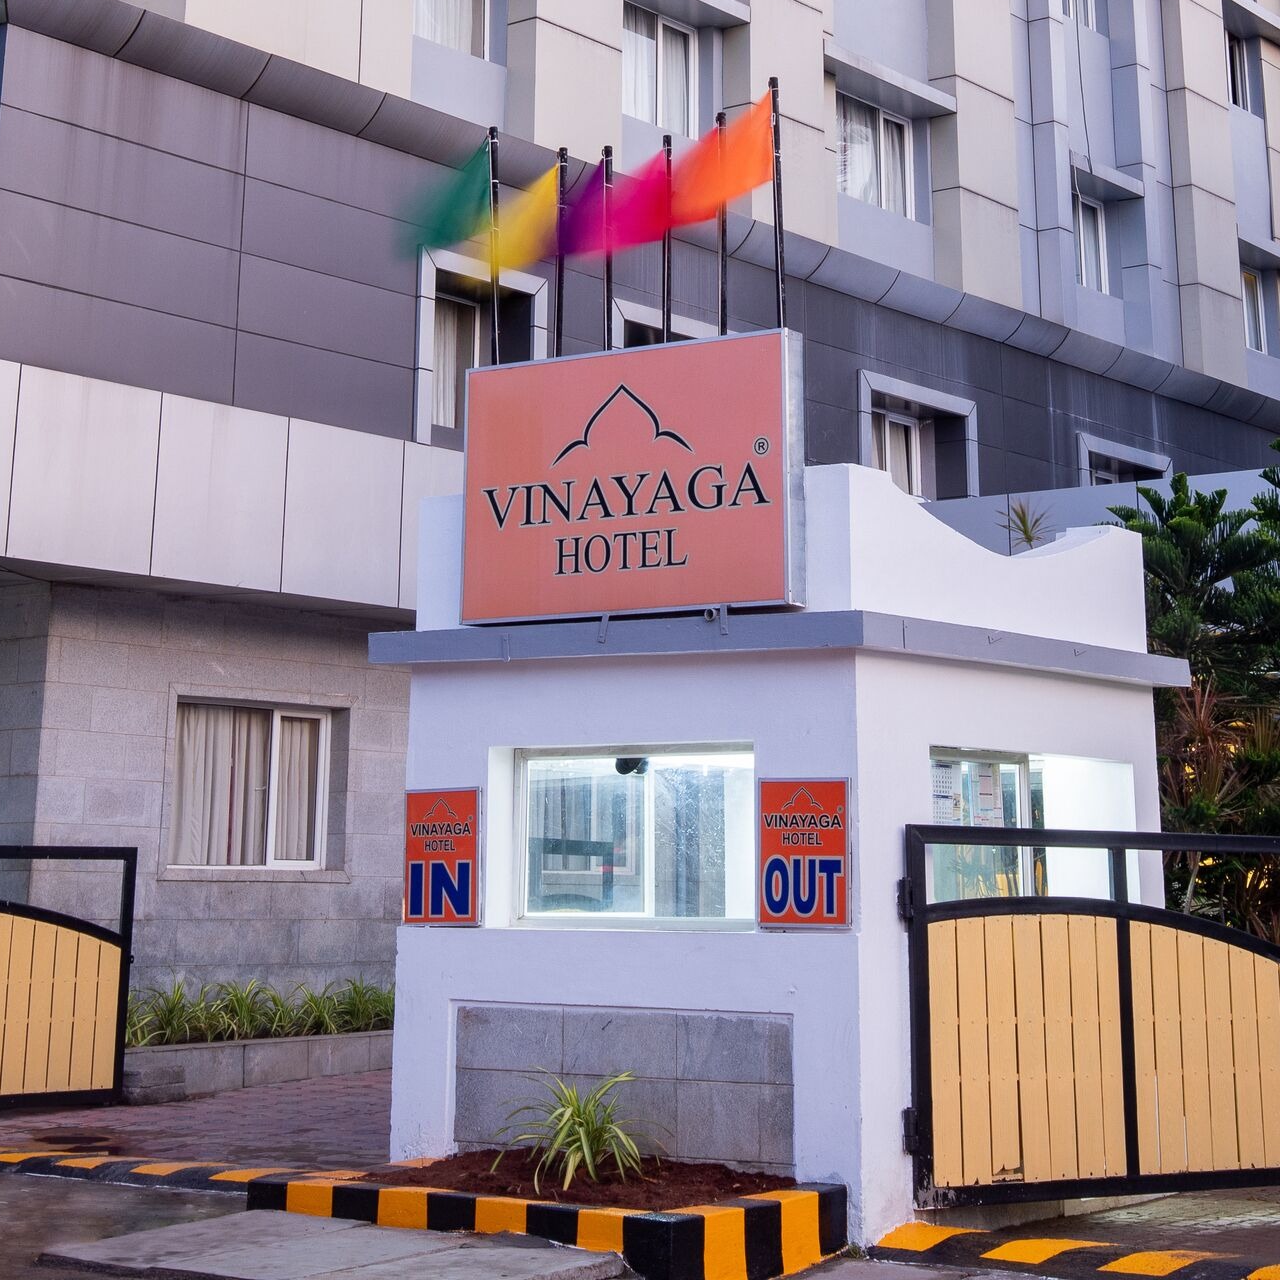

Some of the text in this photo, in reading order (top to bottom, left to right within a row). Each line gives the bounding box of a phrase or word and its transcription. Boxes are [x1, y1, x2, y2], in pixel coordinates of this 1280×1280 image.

[482, 461, 771, 529] VINAYAGA
[554, 527, 689, 576] HOTEL
[410, 822, 472, 836] VINAYAGA
[763, 814, 843, 829] VINAYAGA
[423, 840, 456, 852] HOTEL
[782, 832, 823, 846] HOTEL
[408, 860, 472, 918] IN
[763, 854, 845, 918] OUT
